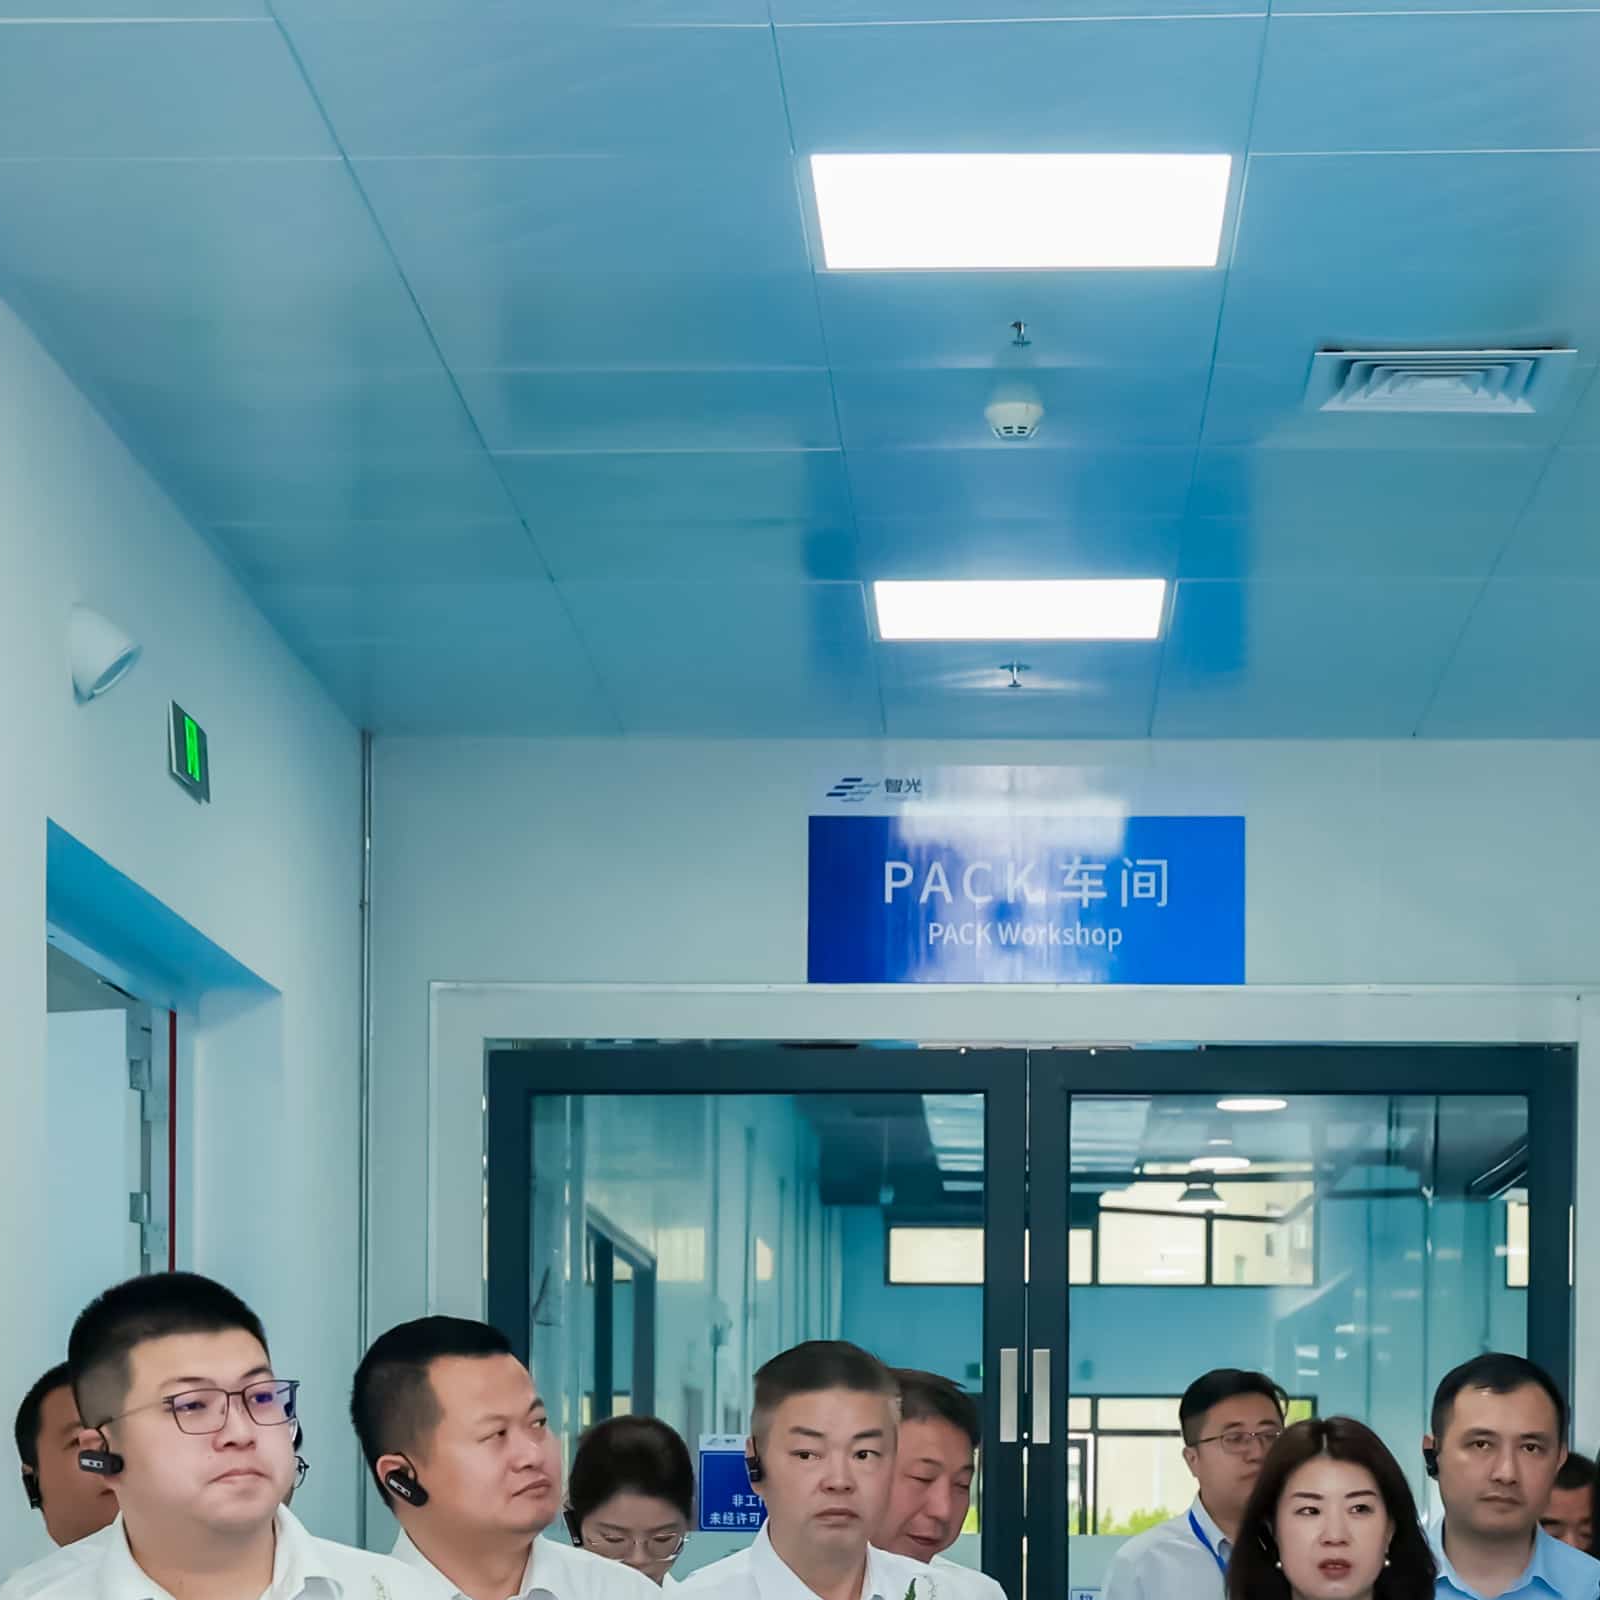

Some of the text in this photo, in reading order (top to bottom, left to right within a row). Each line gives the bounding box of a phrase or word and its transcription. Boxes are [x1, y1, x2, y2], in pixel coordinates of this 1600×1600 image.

[884, 777, 922, 793] 智光
[884, 855, 1168, 909] PACK 车间
[928, 921, 1123, 953] PACK Workshop
[709, 1511, 760, 1525] 未经许可
